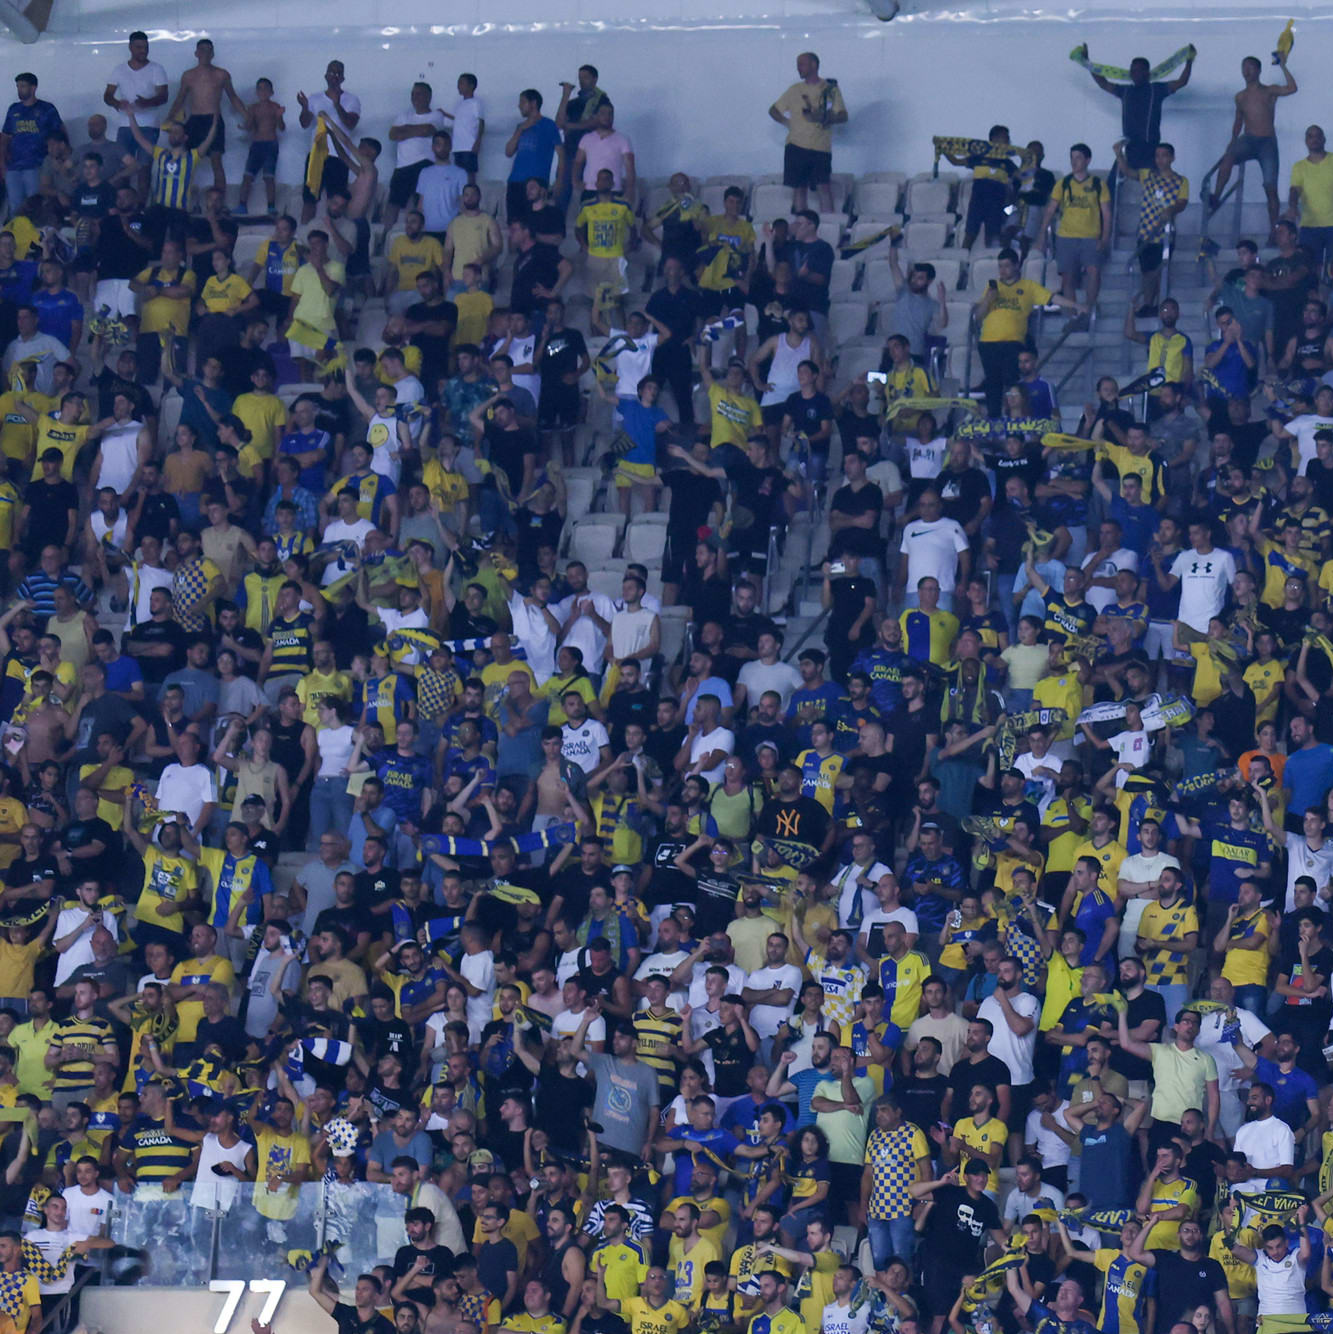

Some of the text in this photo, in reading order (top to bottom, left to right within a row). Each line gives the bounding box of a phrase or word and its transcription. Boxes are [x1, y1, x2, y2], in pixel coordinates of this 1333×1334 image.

[387, 771, 412, 781] ISRAEL
[384, 778, 414, 789] CANADA
[1222, 847, 1250, 857] QATAR
[138, 1137, 172, 1145] CANADA
[209, 1280, 286, 1334] 77
[640, 1321, 668, 1331] ISRAEL
